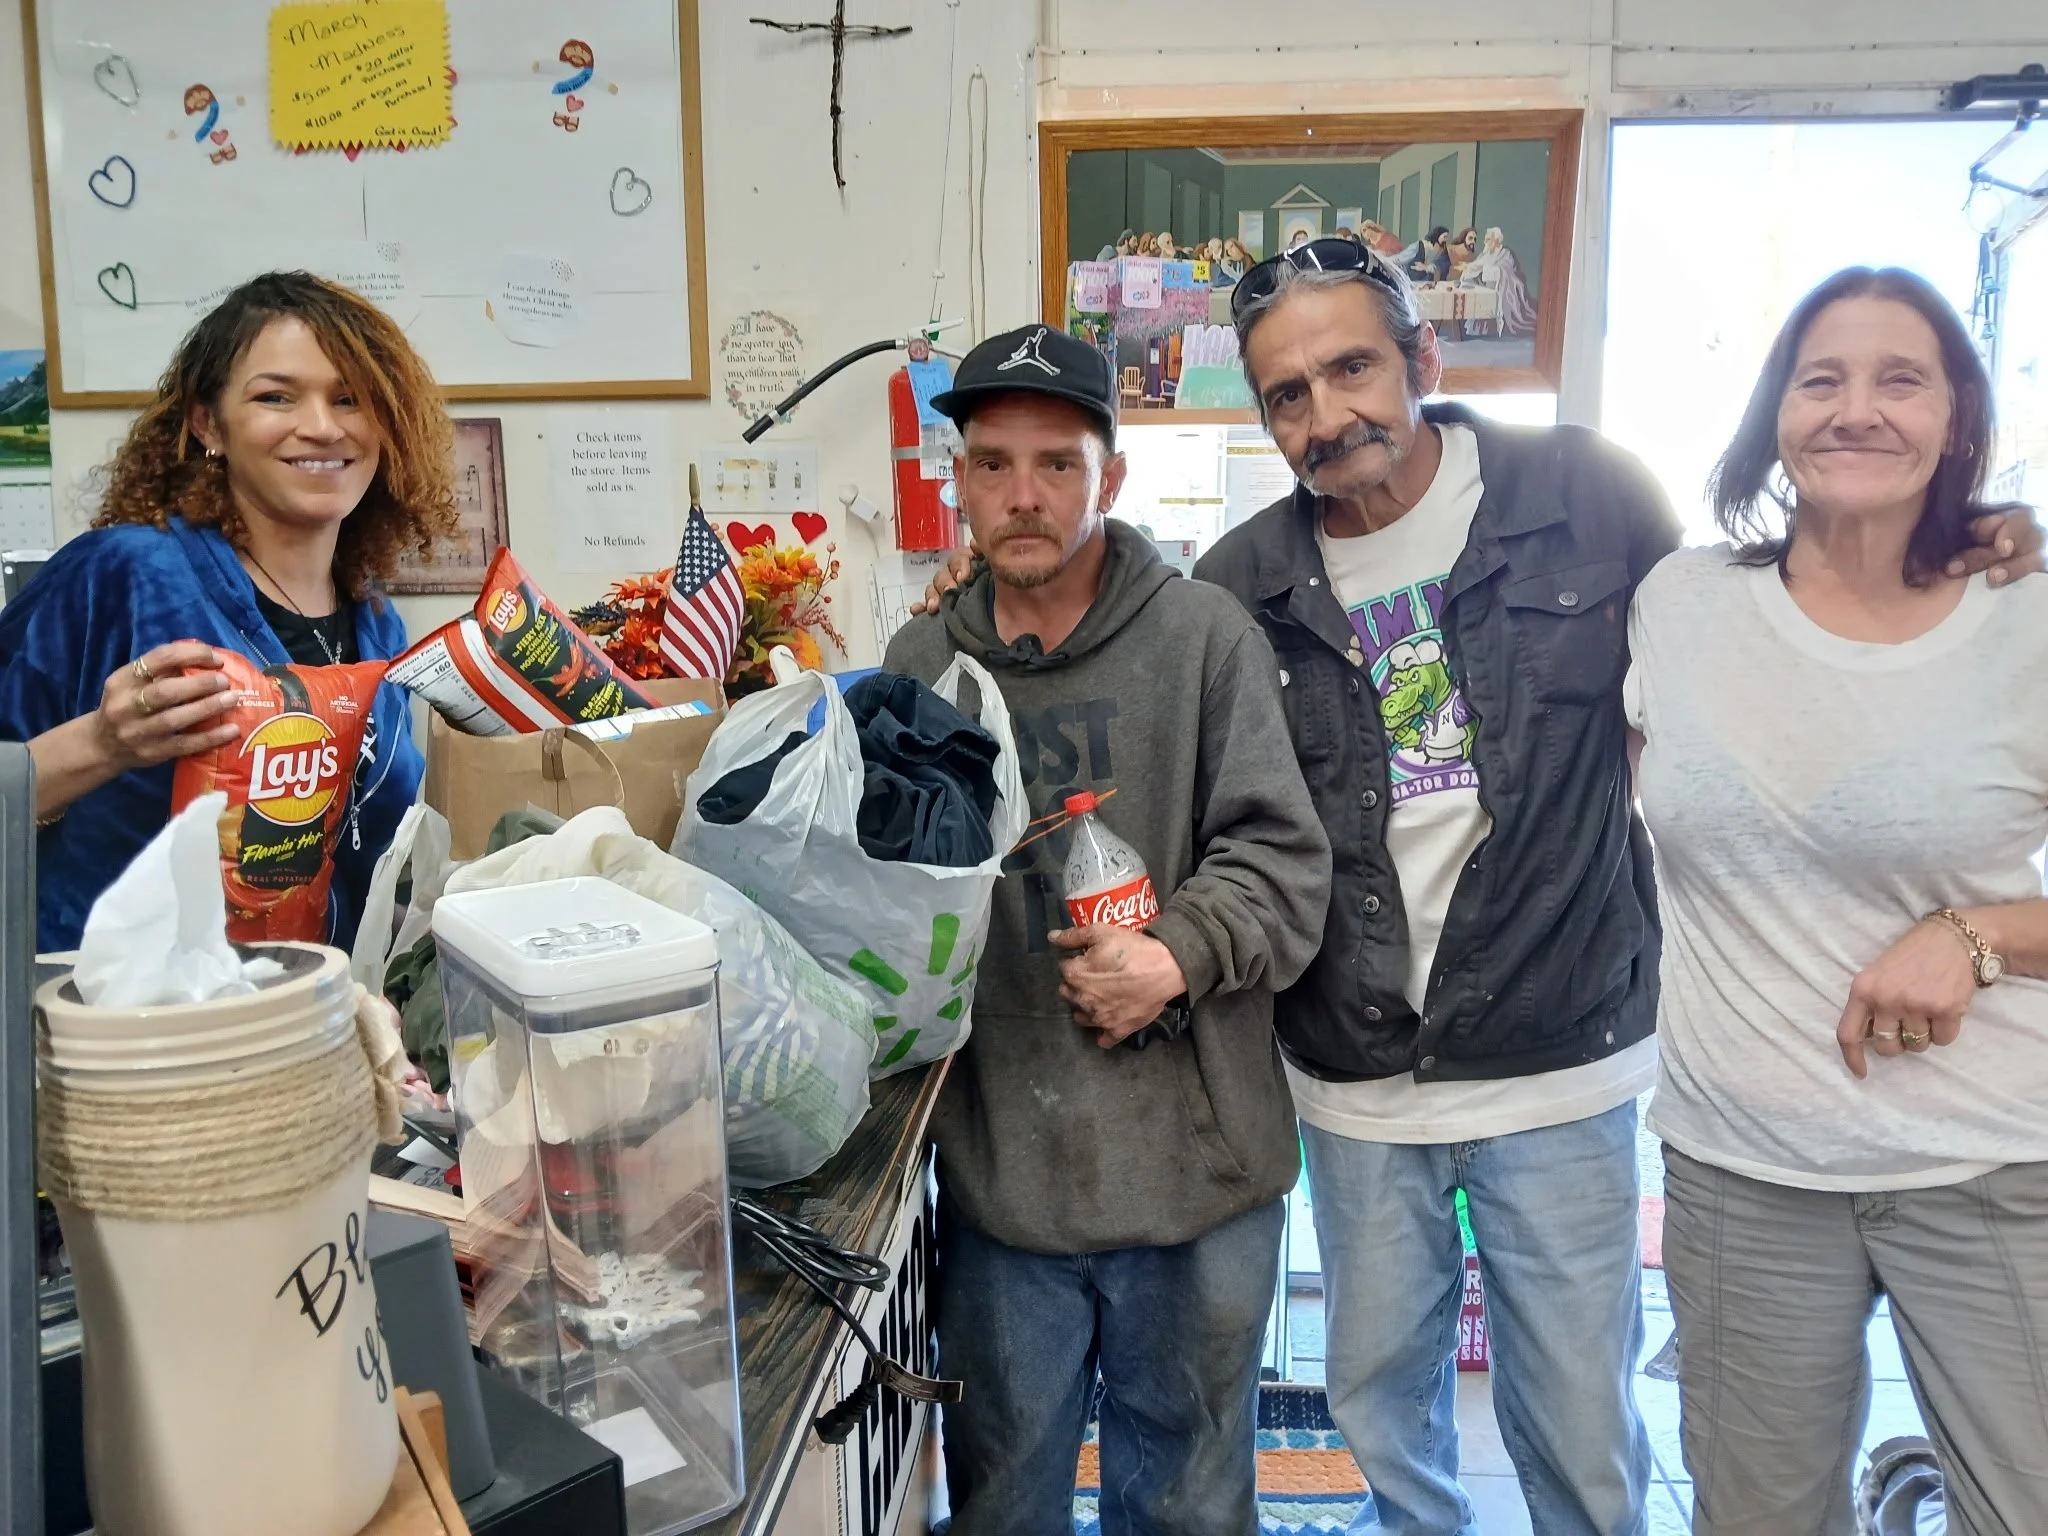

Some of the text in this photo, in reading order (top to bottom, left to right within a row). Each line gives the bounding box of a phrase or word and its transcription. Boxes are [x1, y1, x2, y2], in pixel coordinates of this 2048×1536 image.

[576, 431, 642, 443] Check items
[572, 447, 648, 461] before leaving
[571, 465, 588, 476] the
[622, 464, 651, 475] Items
[586, 481, 608, 492] sold
[611, 483, 622, 492] as
[584, 535, 647, 546] No Refunds
[488, 590, 518, 633] Lay's
[434, 660, 451, 676] 160
[1441, 712, 1451, 726] N
[1013, 697, 1119, 787] UST
[247, 736, 339, 800] Lay's
[297, 830, 324, 850] Hot
[247, 874, 269, 883] REAL
